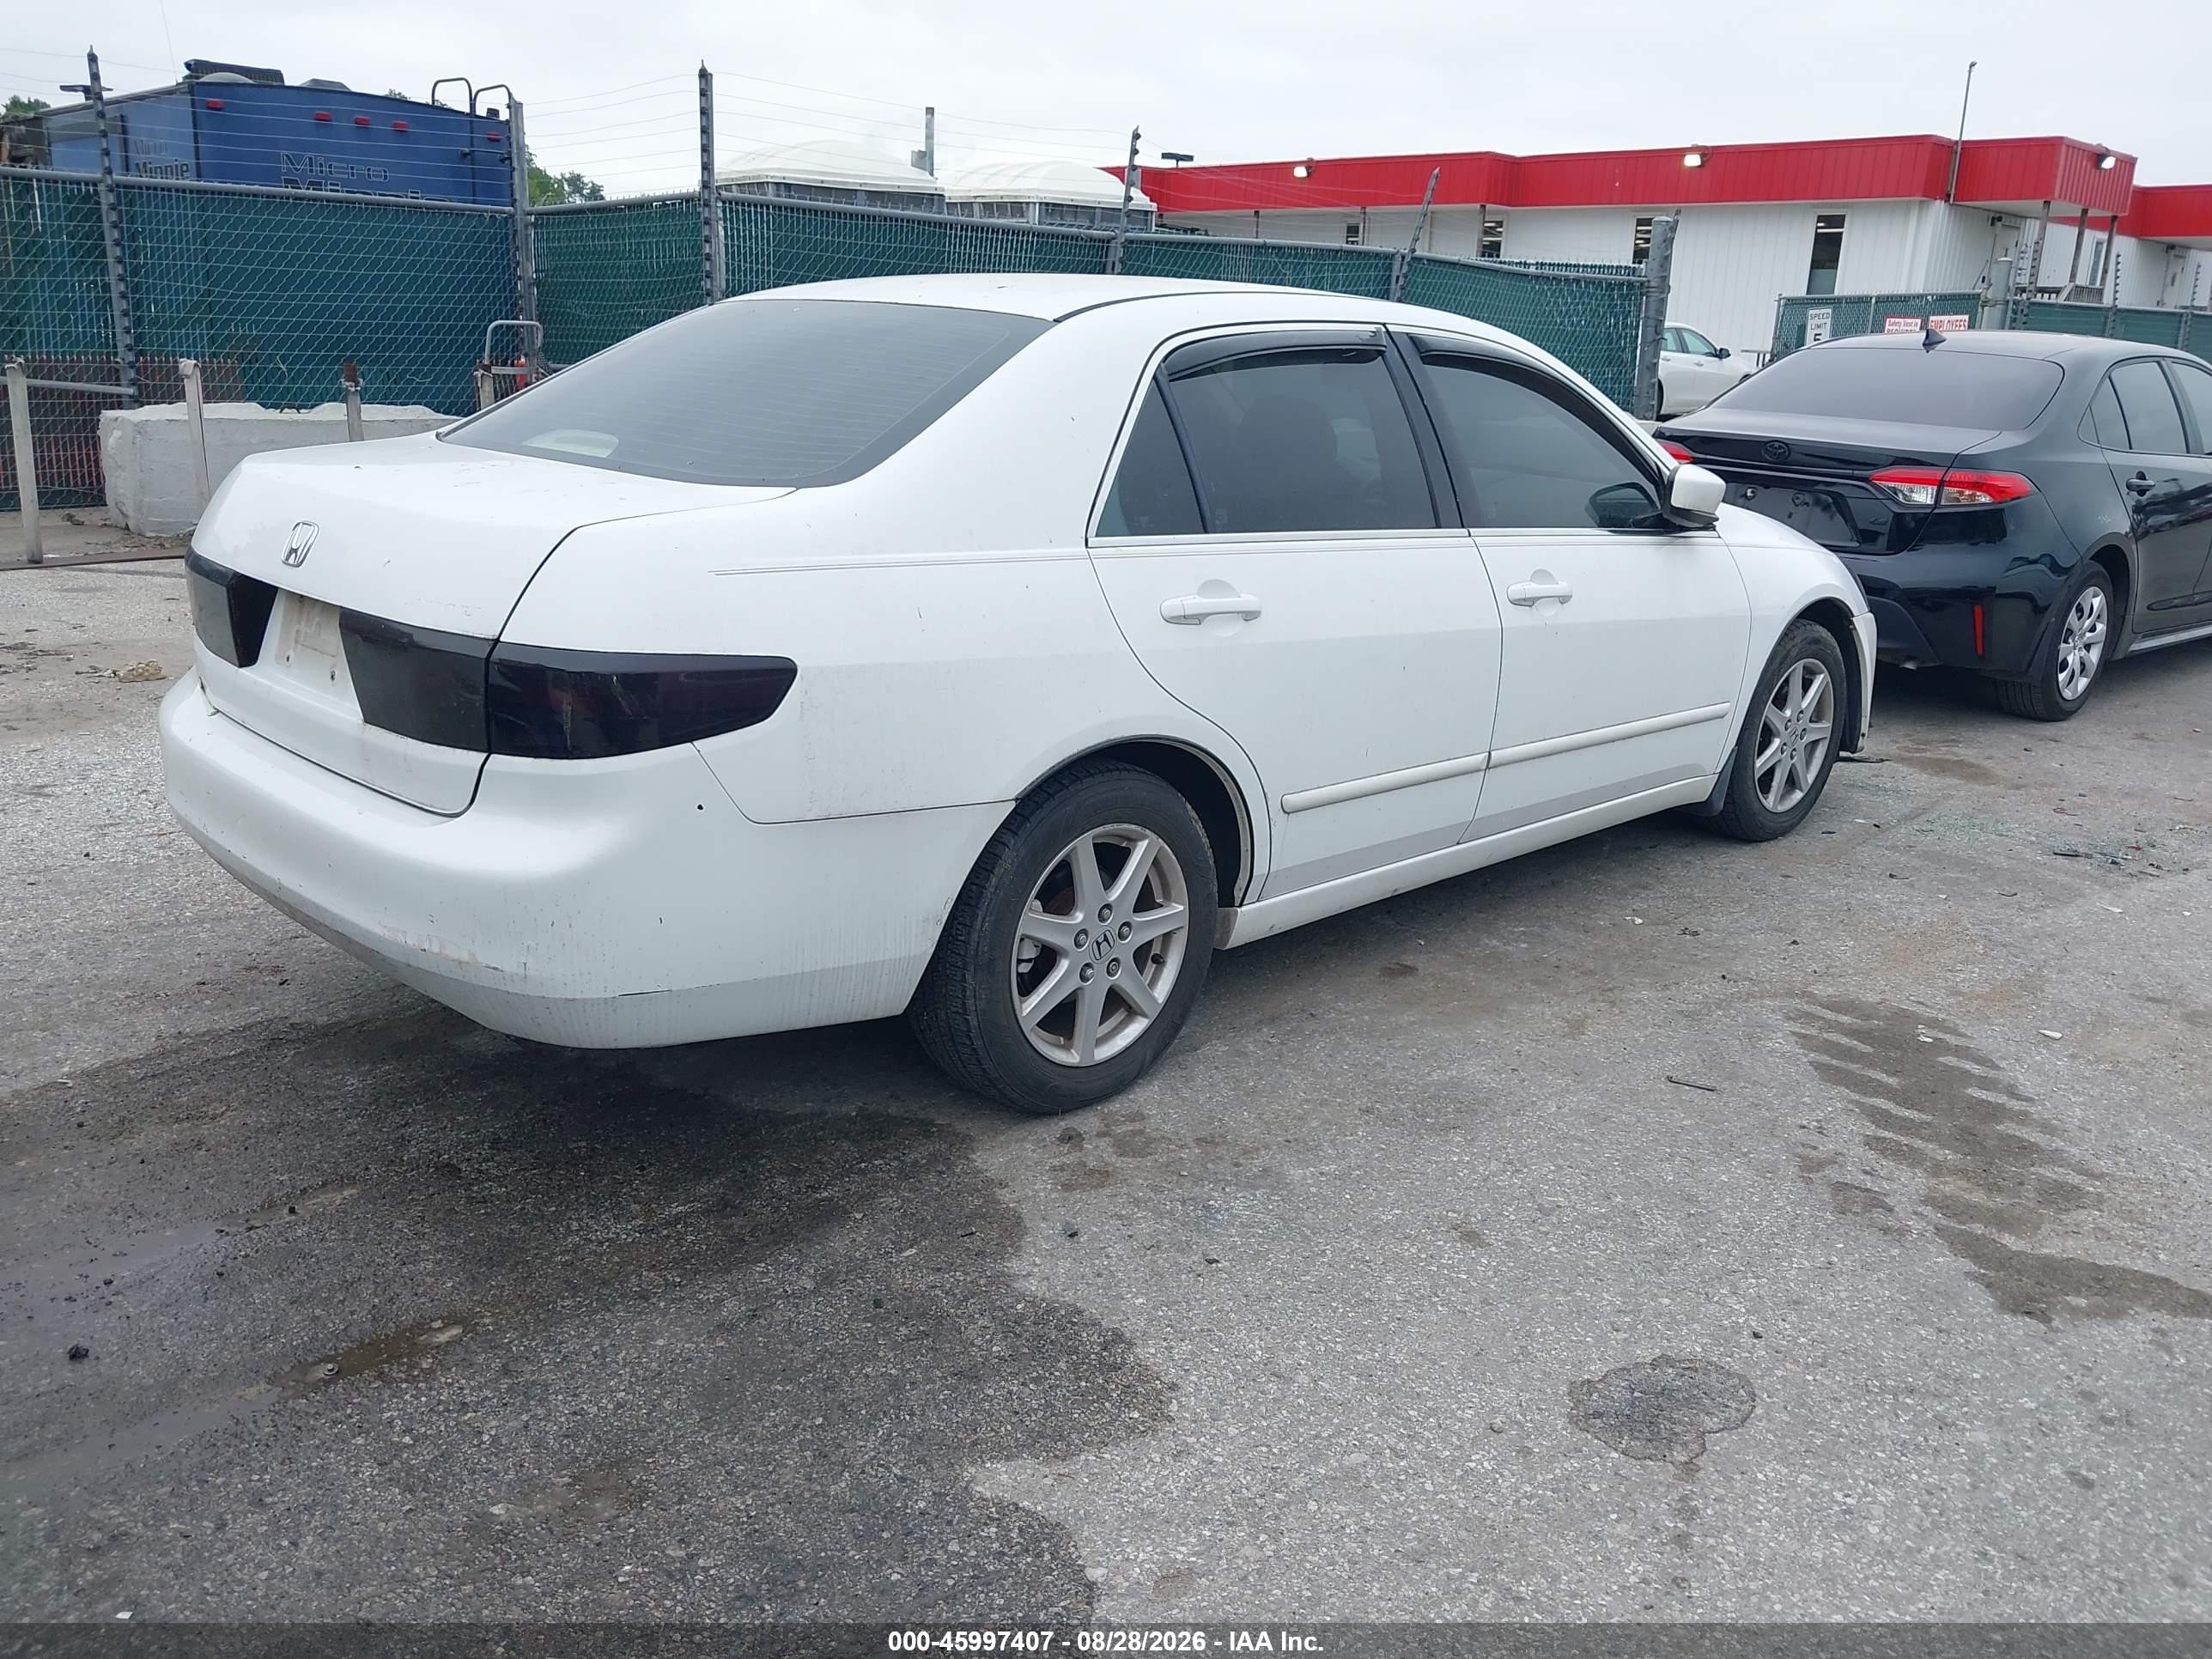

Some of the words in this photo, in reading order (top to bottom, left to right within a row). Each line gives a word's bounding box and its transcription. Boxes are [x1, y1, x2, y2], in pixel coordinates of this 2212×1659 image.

[281, 150, 389, 182] Micro
[1810, 312, 1830, 320] SPEED
[1810, 322, 1827, 331] LIMIT
[1888, 319, 1902, 329] Safety
